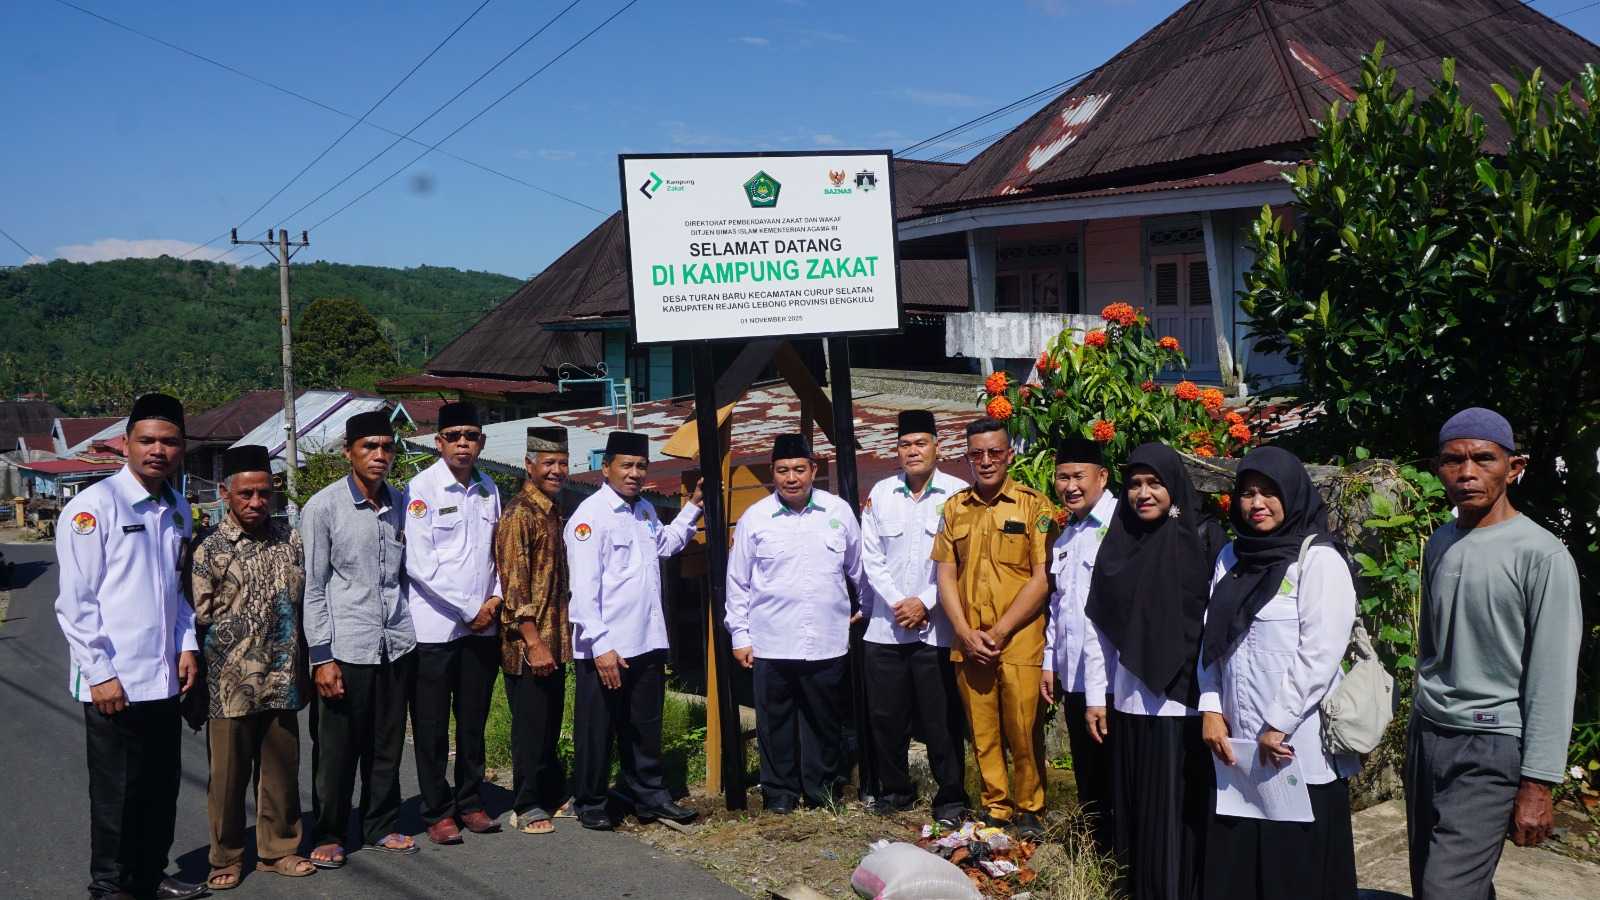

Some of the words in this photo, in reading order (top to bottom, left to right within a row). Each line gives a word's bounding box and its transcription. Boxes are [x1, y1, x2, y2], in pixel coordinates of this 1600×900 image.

[684, 219, 727, 227] DIREKTORAT
[689, 240, 770, 257] SELAMAT
[775, 238, 842, 255] DATANG
[652, 264, 675, 286] DI
[682, 260, 799, 284] KAMPUNG
[806, 256, 878, 280] ZAKAT
[662, 295, 687, 303] DESA
[689, 293, 720, 302] TURAN
[722, 292, 746, 301] BARU
[748, 289, 802, 299] KECAMATAN
[803, 287, 834, 296] CURUP
[835, 286, 873, 295] SELATAN
[662, 303, 714, 313] KABUPATEN
[716, 302, 750, 310] REJANG
[752, 300, 787, 309] LEBONG
[789, 298, 828, 307] PROVINSI
[829, 296, 874, 305] BENGKULU
